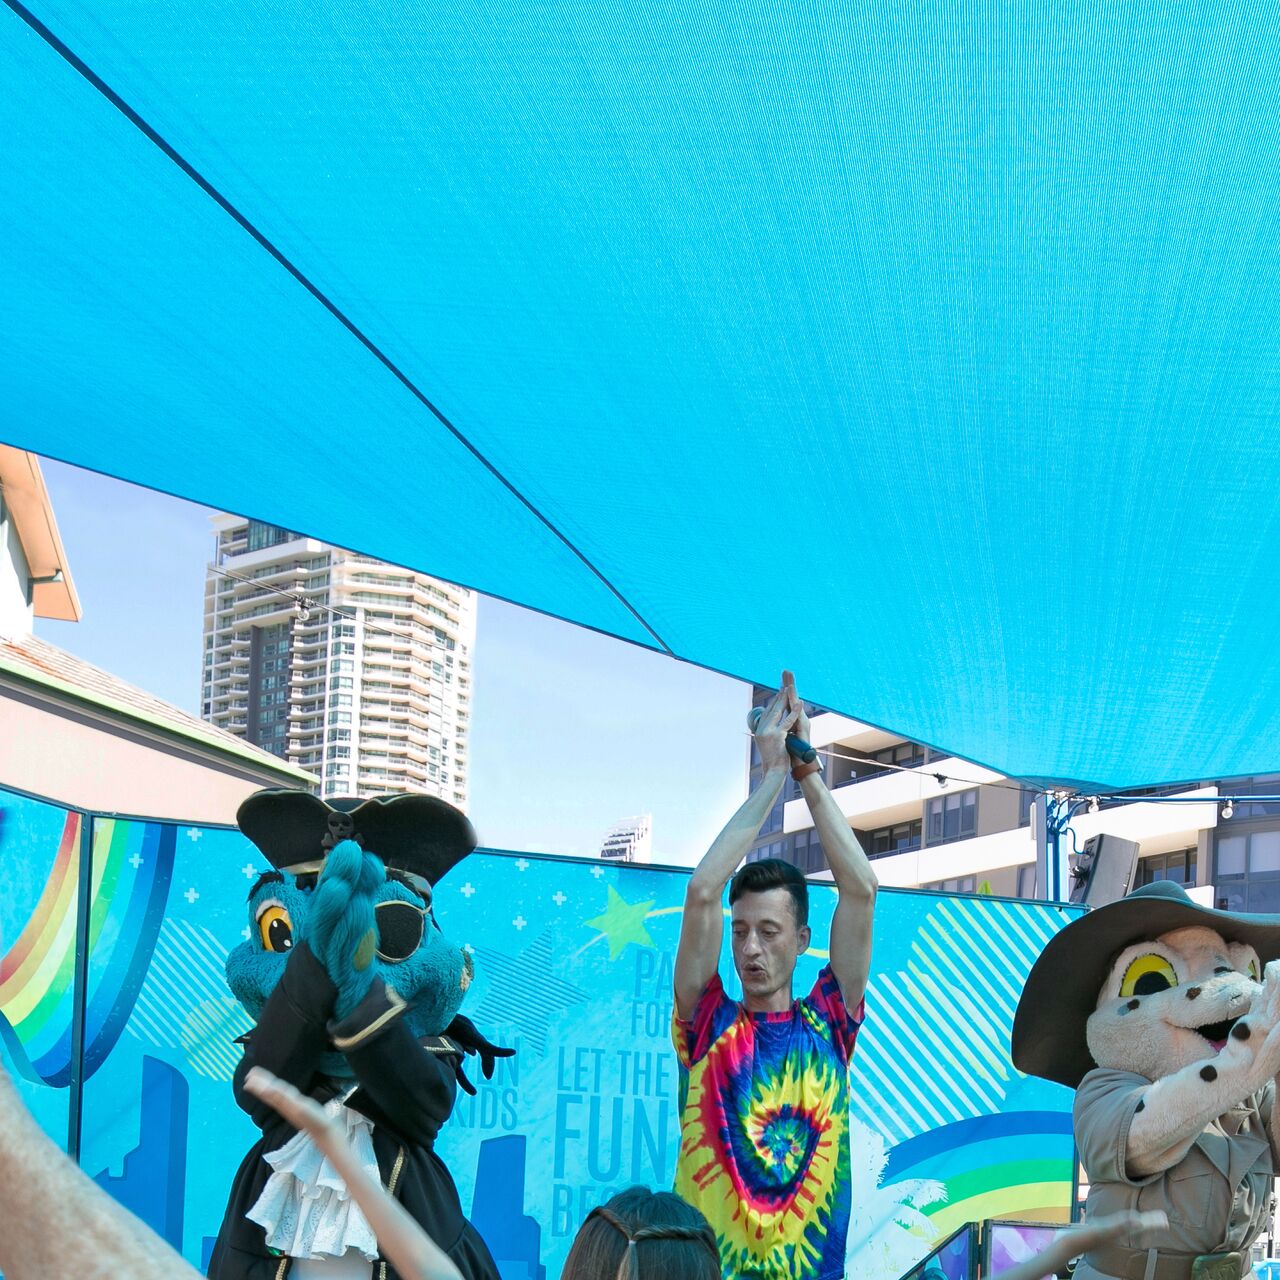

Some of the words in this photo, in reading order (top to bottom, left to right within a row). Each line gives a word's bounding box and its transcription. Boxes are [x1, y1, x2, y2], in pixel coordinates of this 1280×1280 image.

[557, 1046, 605, 1093] LET
[617, 1051, 669, 1097] THE
[553, 1093, 668, 1185] FUN
